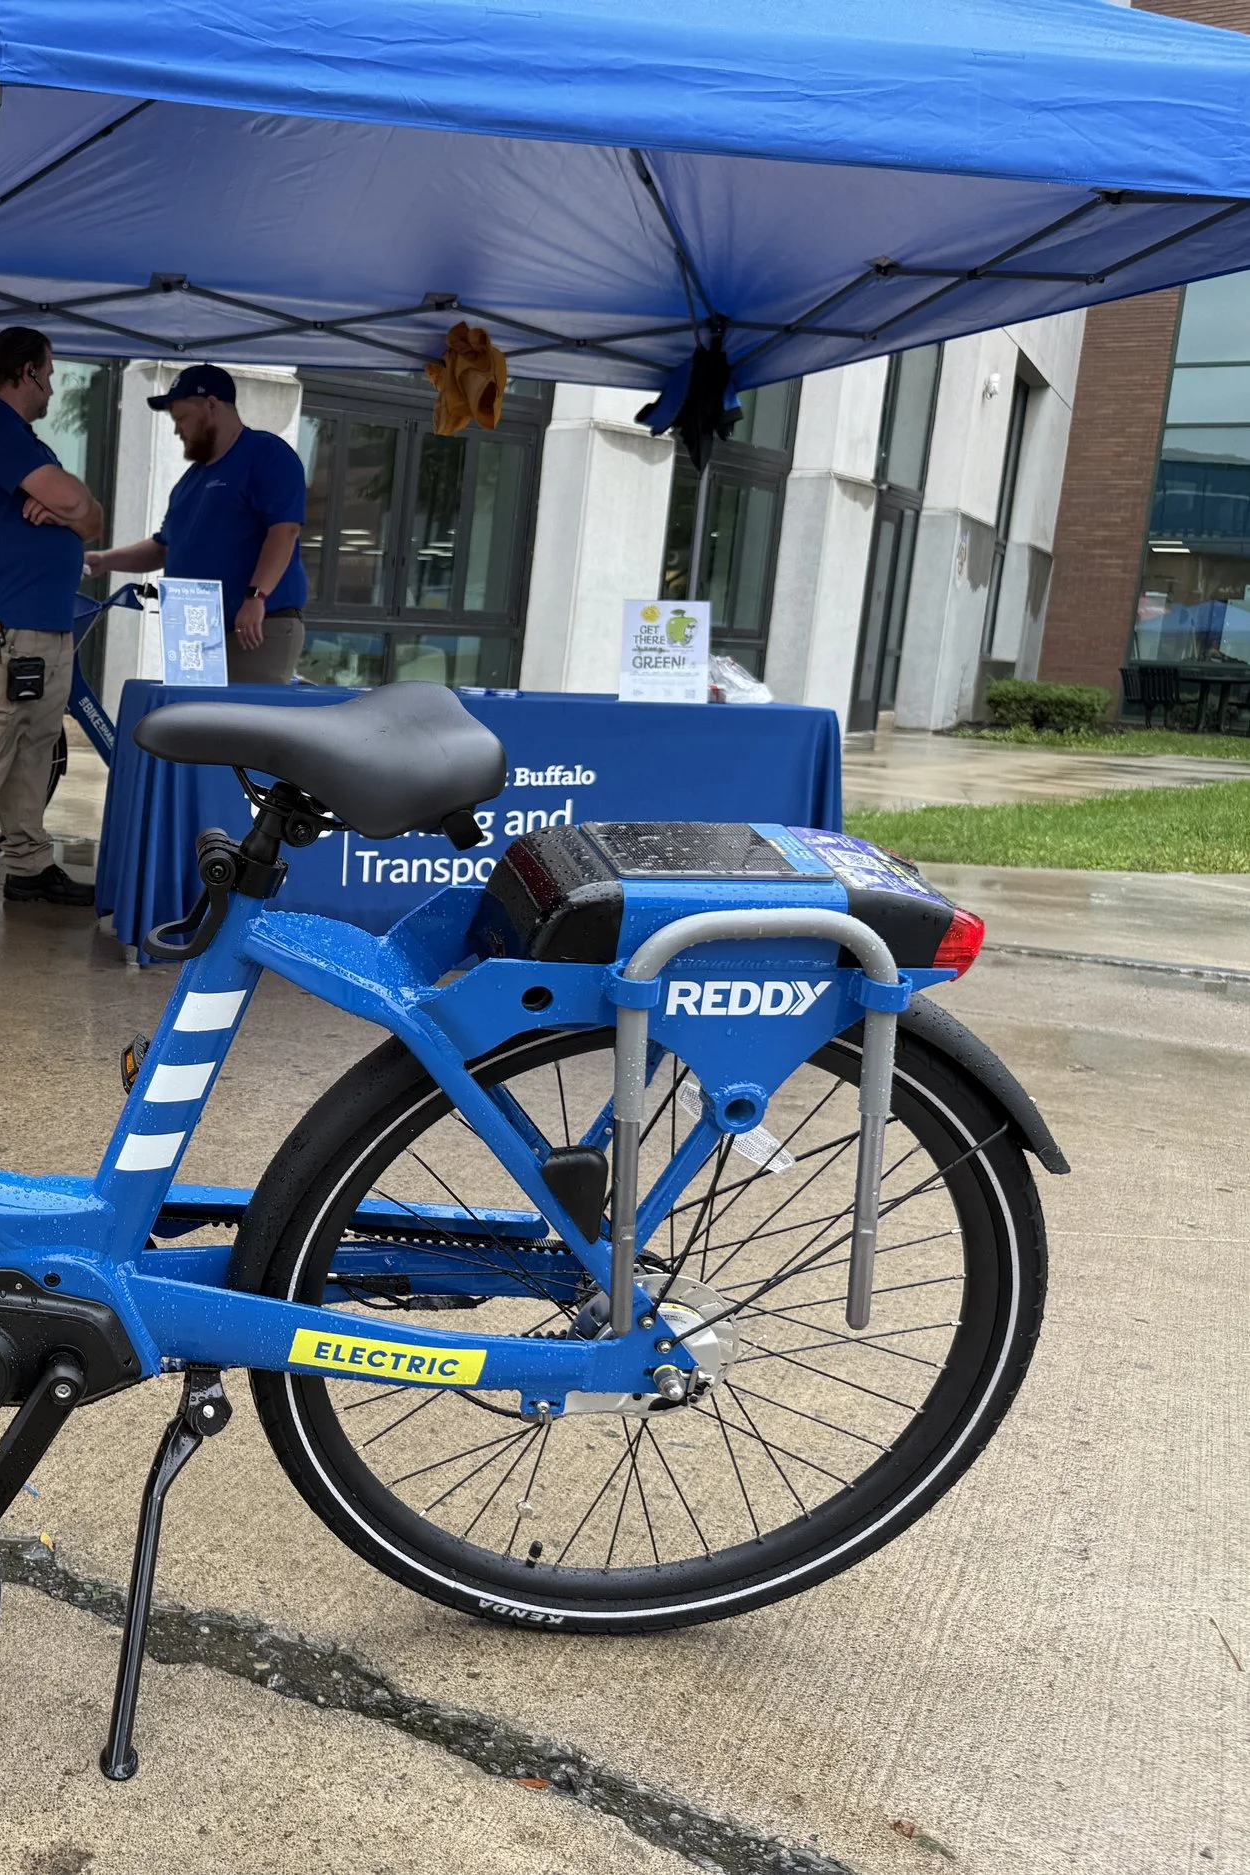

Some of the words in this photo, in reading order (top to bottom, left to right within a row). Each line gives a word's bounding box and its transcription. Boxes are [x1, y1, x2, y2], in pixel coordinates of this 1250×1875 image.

[633, 635, 666, 645] THERE
[640, 625, 659, 635] GET
[632, 656, 687, 669] GREEN!
[513, 765, 596, 787] Buffalo
[504, 798, 573, 836] and
[666, 981, 832, 1016] REDDY
[314, 1341, 460, 1377] ELECTRIC
[478, 1598, 564, 1625] KENDA
